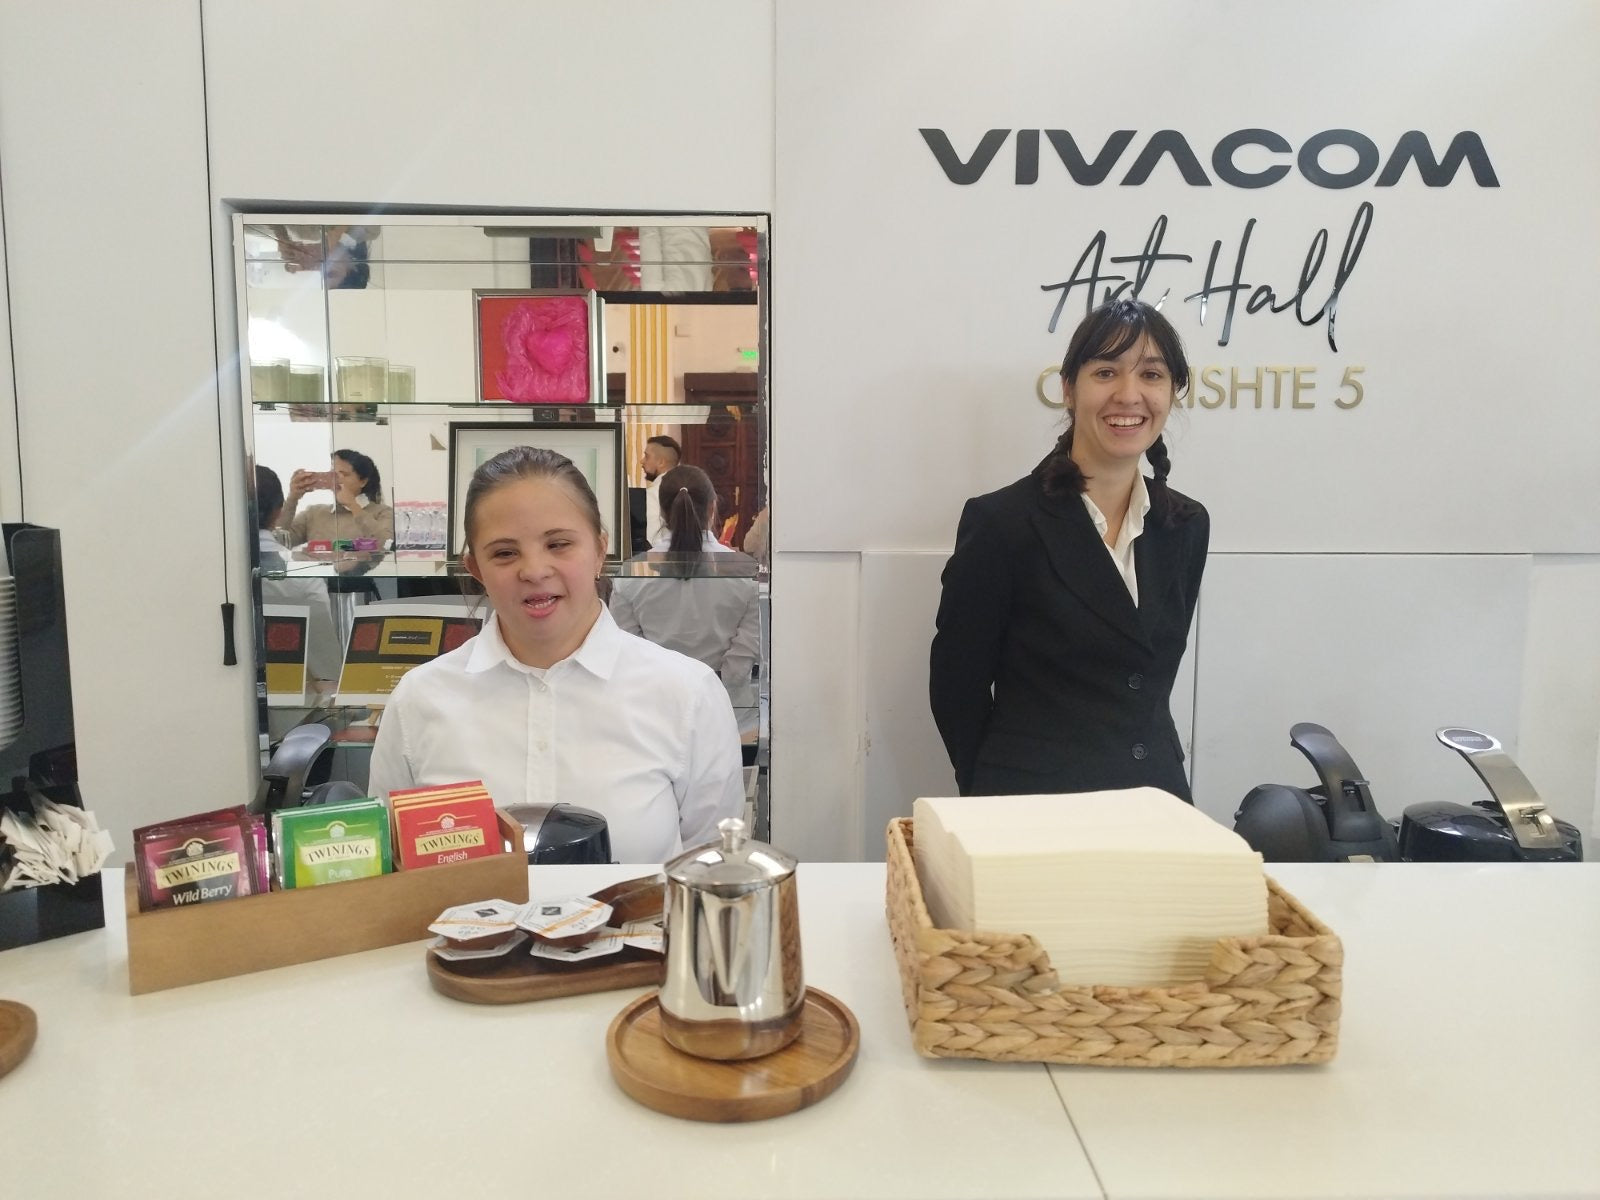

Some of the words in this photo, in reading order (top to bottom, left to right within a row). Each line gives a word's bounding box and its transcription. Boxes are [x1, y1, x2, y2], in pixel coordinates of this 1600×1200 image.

[918, 128, 1500, 189] VIVACOM
[1040, 214, 1193, 333] Art
[1184, 201, 1374, 352] Hall
[1334, 365, 1366, 410] 5
[305, 844, 371, 862] TWININGS
[421, 833, 479, 852] TWININGS
[437, 851, 468, 864] English
[164, 860, 234, 884] TWININGS
[172, 888, 200, 905] Wild
[201, 884, 232, 899] Berry
